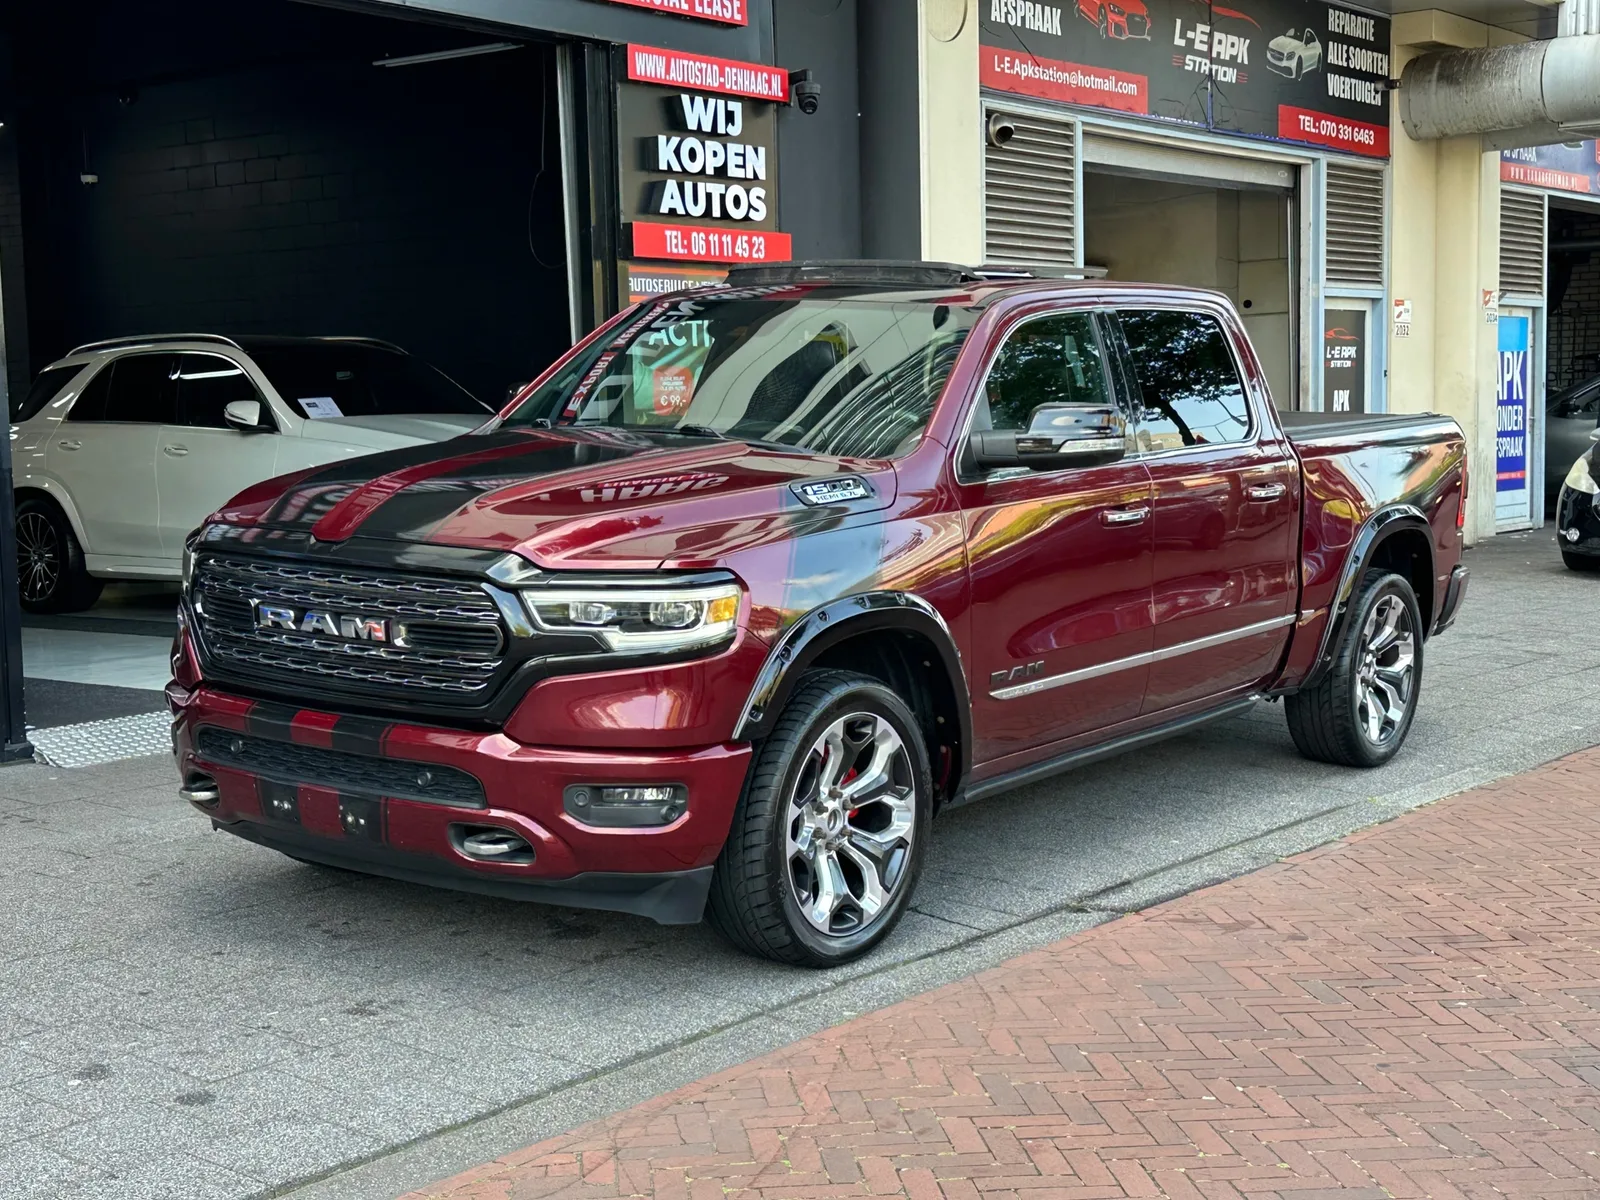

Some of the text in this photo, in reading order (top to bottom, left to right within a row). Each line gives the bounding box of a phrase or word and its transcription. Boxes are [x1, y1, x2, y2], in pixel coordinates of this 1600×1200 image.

[991, 0, 1062, 36] AFSPRAAK
[1328, 8, 1375, 42] REPARATIE
[1173, 18, 1251, 65] L-E APK
[1327, 41, 1389, 77] ALLE SOORTEN
[635, 51, 783, 97] WWW.AUTOSTAD-DENHAAG.NL
[994, 54, 1138, 96] L-E.Apkstation@hotmail.com
[1184, 54, 1237, 84] STATION
[681, 94, 742, 136] WIJ
[1298, 115, 1375, 146] TEL: 070 331 6463
[658, 135, 766, 181] KOPEN
[659, 179, 767, 222] AUTOS
[665, 230, 765, 259] TEL: 06 11 11 45 23
[1333, 389, 1350, 412] APK
[803, 480, 854, 496] 1500
[258, 604, 393, 642] RAM
[990, 660, 1045, 684] RAM
